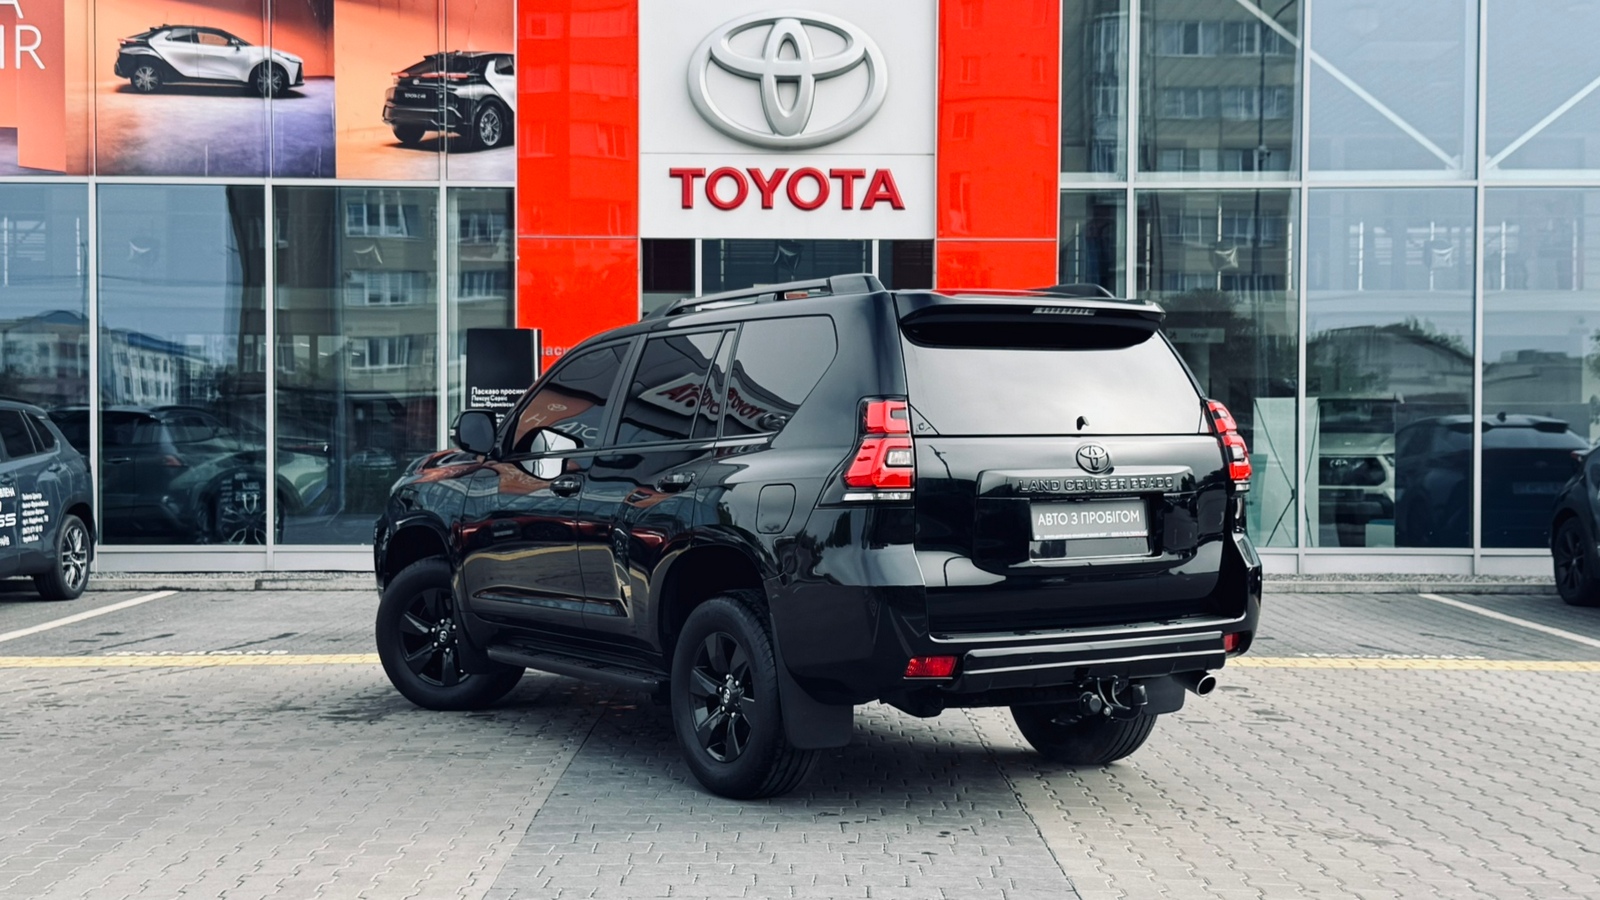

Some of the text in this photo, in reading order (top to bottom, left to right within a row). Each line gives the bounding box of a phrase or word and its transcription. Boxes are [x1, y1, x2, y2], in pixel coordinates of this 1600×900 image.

[669, 166, 906, 211] TOYOTA
[1019, 476, 1174, 493] LAND CRUISER PRADO
[1038, 509, 1140, 526] АВТО З ПРОБІГОМ
